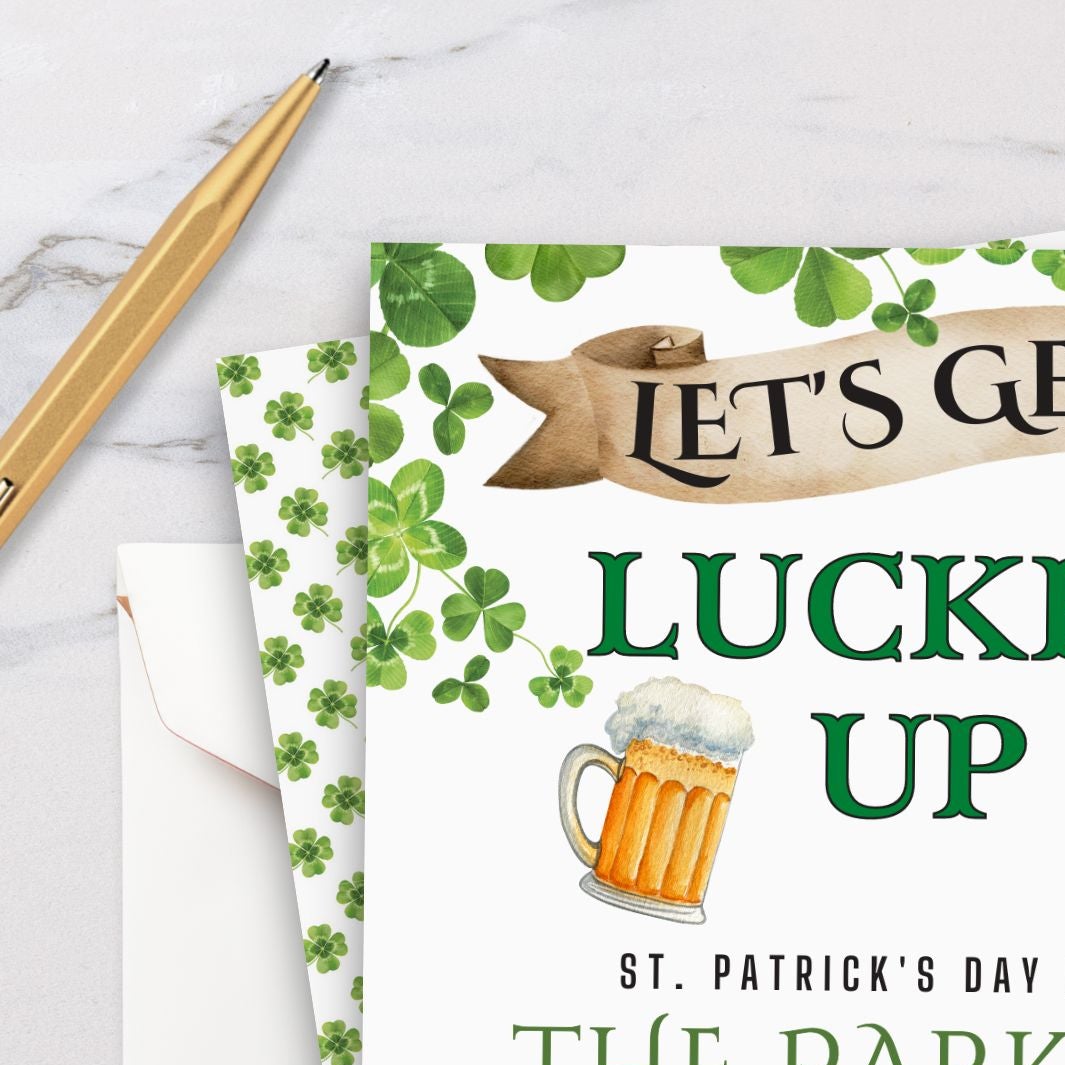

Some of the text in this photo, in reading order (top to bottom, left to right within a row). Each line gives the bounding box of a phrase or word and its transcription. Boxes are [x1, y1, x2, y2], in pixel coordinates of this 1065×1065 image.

[627, 358, 904, 488] LET'S
[810, 712, 1028, 821] UP
[620, 952, 683, 990] ST.
[714, 953, 934, 993] PATRICK'S
[965, 956, 1039, 994] DAY
